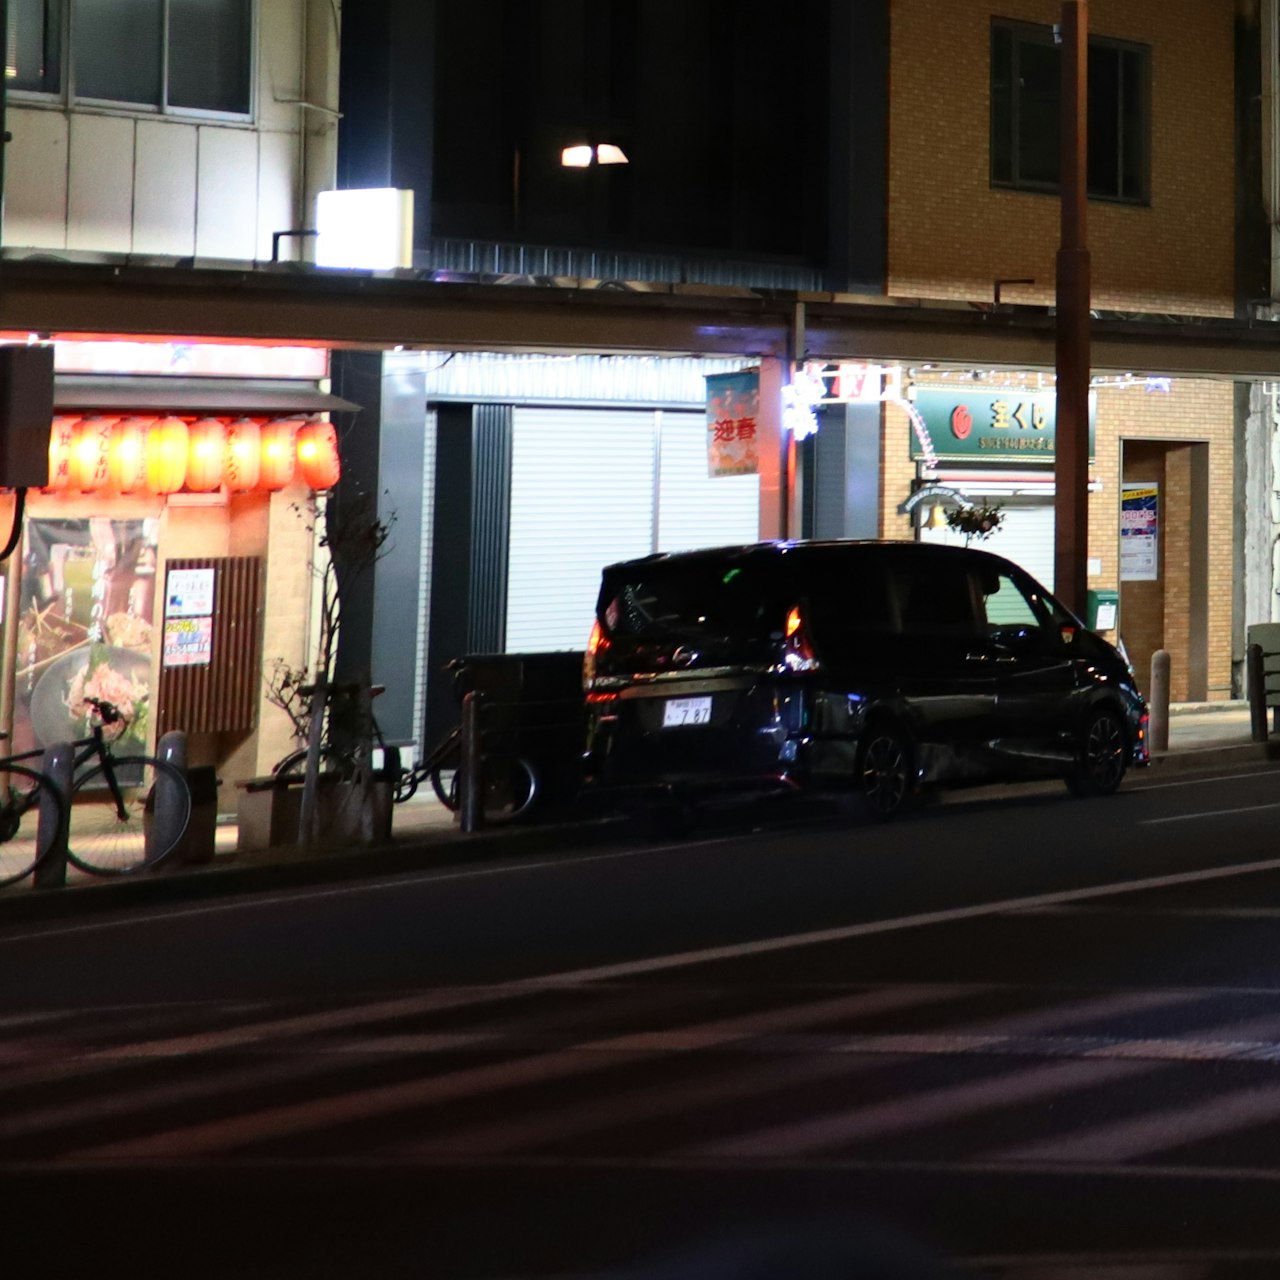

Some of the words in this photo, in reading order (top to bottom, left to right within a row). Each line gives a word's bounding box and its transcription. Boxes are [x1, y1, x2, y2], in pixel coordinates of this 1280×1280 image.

[990, 399, 1048, 430] 宝くじ
[713, 416, 758, 442] 迎春
